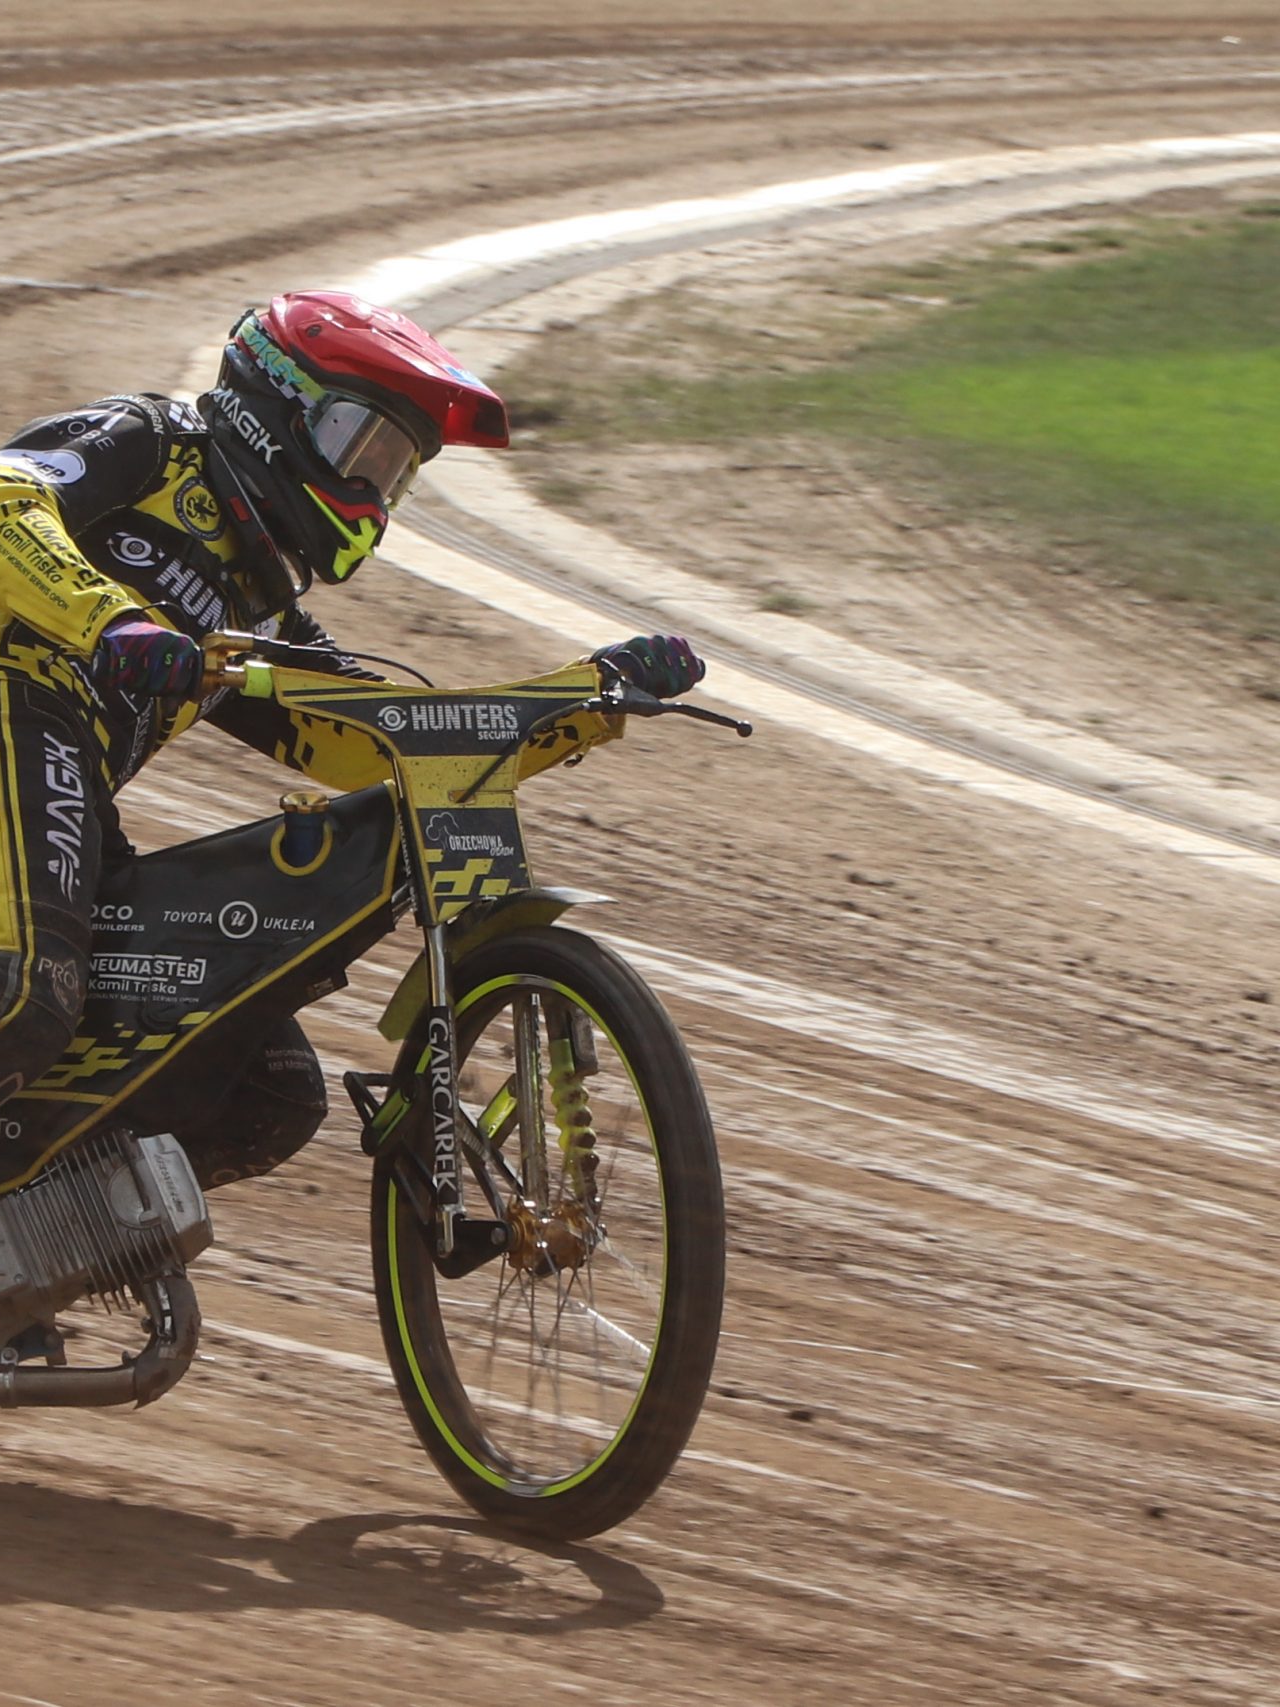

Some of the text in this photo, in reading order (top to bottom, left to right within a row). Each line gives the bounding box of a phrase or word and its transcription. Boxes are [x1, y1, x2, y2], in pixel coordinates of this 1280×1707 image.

[27, 547, 64, 584] Triska
[411, 704, 519, 731] HUNTERS
[478, 731, 520, 741] SECURITY
[449, 834, 503, 851] ORZECHOWA
[92, 923, 145, 933] BUILDERS
[162, 910, 213, 924] TOYOTA
[263, 916, 316, 931] UKLEJA
[88, 978, 177, 994] Kamil Triska
[428, 1016, 457, 1193] GARCAREK
